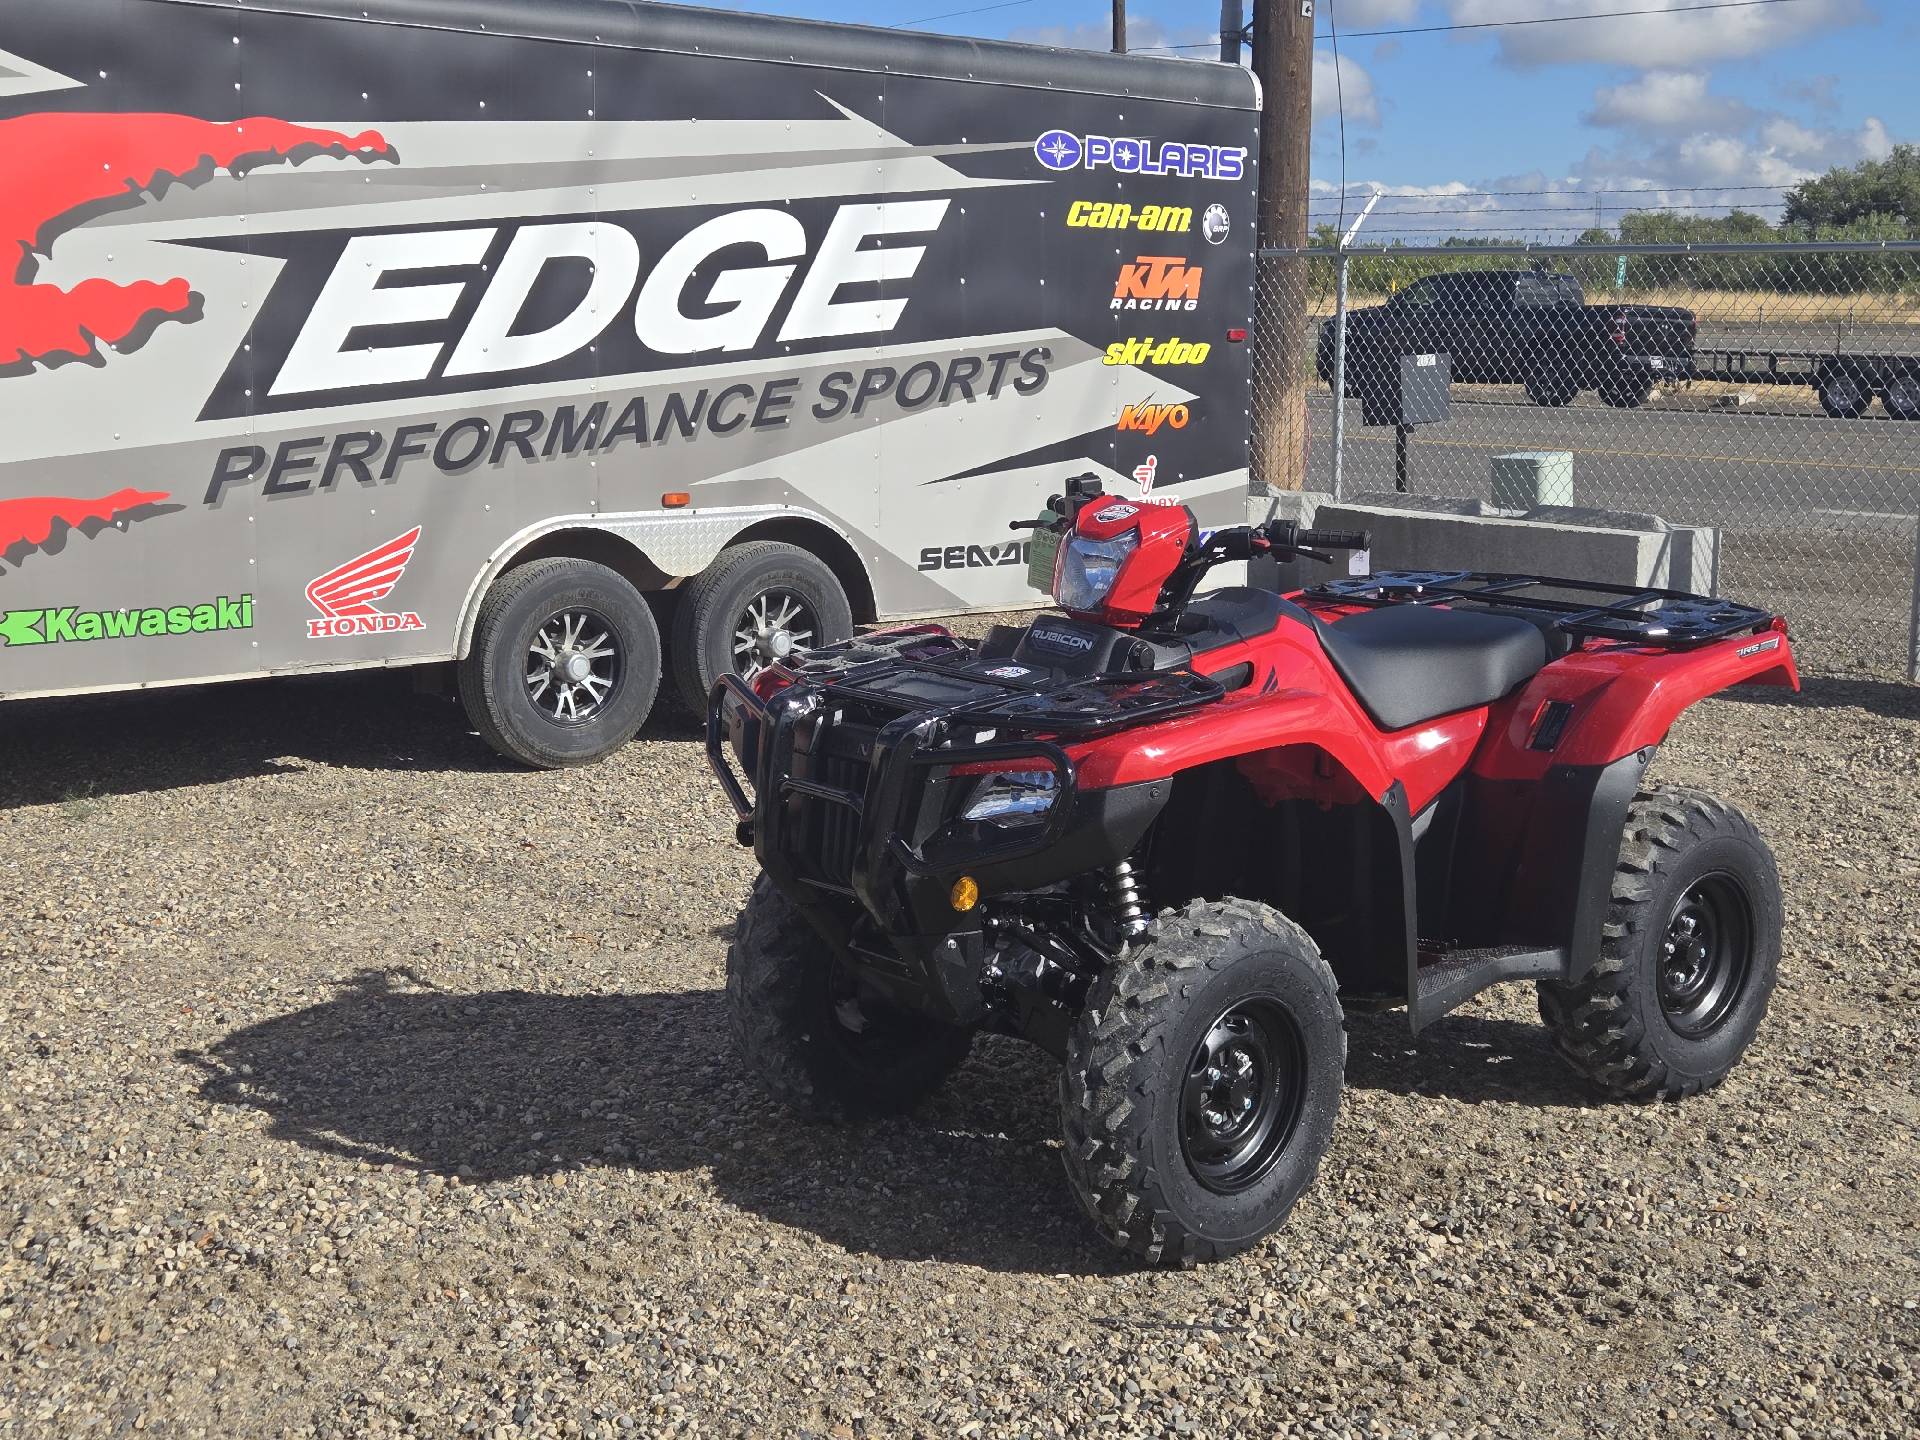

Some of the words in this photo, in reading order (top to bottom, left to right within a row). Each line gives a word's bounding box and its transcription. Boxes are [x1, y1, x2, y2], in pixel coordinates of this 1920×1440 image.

[1085, 135, 1245, 180] POLARIS
[1212, 225, 1229, 233] BRP
[1113, 256, 1202, 299] KTM
[266, 198, 951, 397] EDGE
[1110, 299, 1198, 311] RACING
[1102, 336, 1211, 366] ski-doo
[203, 376, 815, 506] PERFORMANCE
[811, 346, 1054, 421] SPORTS
[1117, 400, 1189, 435] KAYO
[45, 594, 253, 643] Kawasaki
[306, 611, 426, 638] HONDA
[1031, 629, 1093, 651] RUBICON
